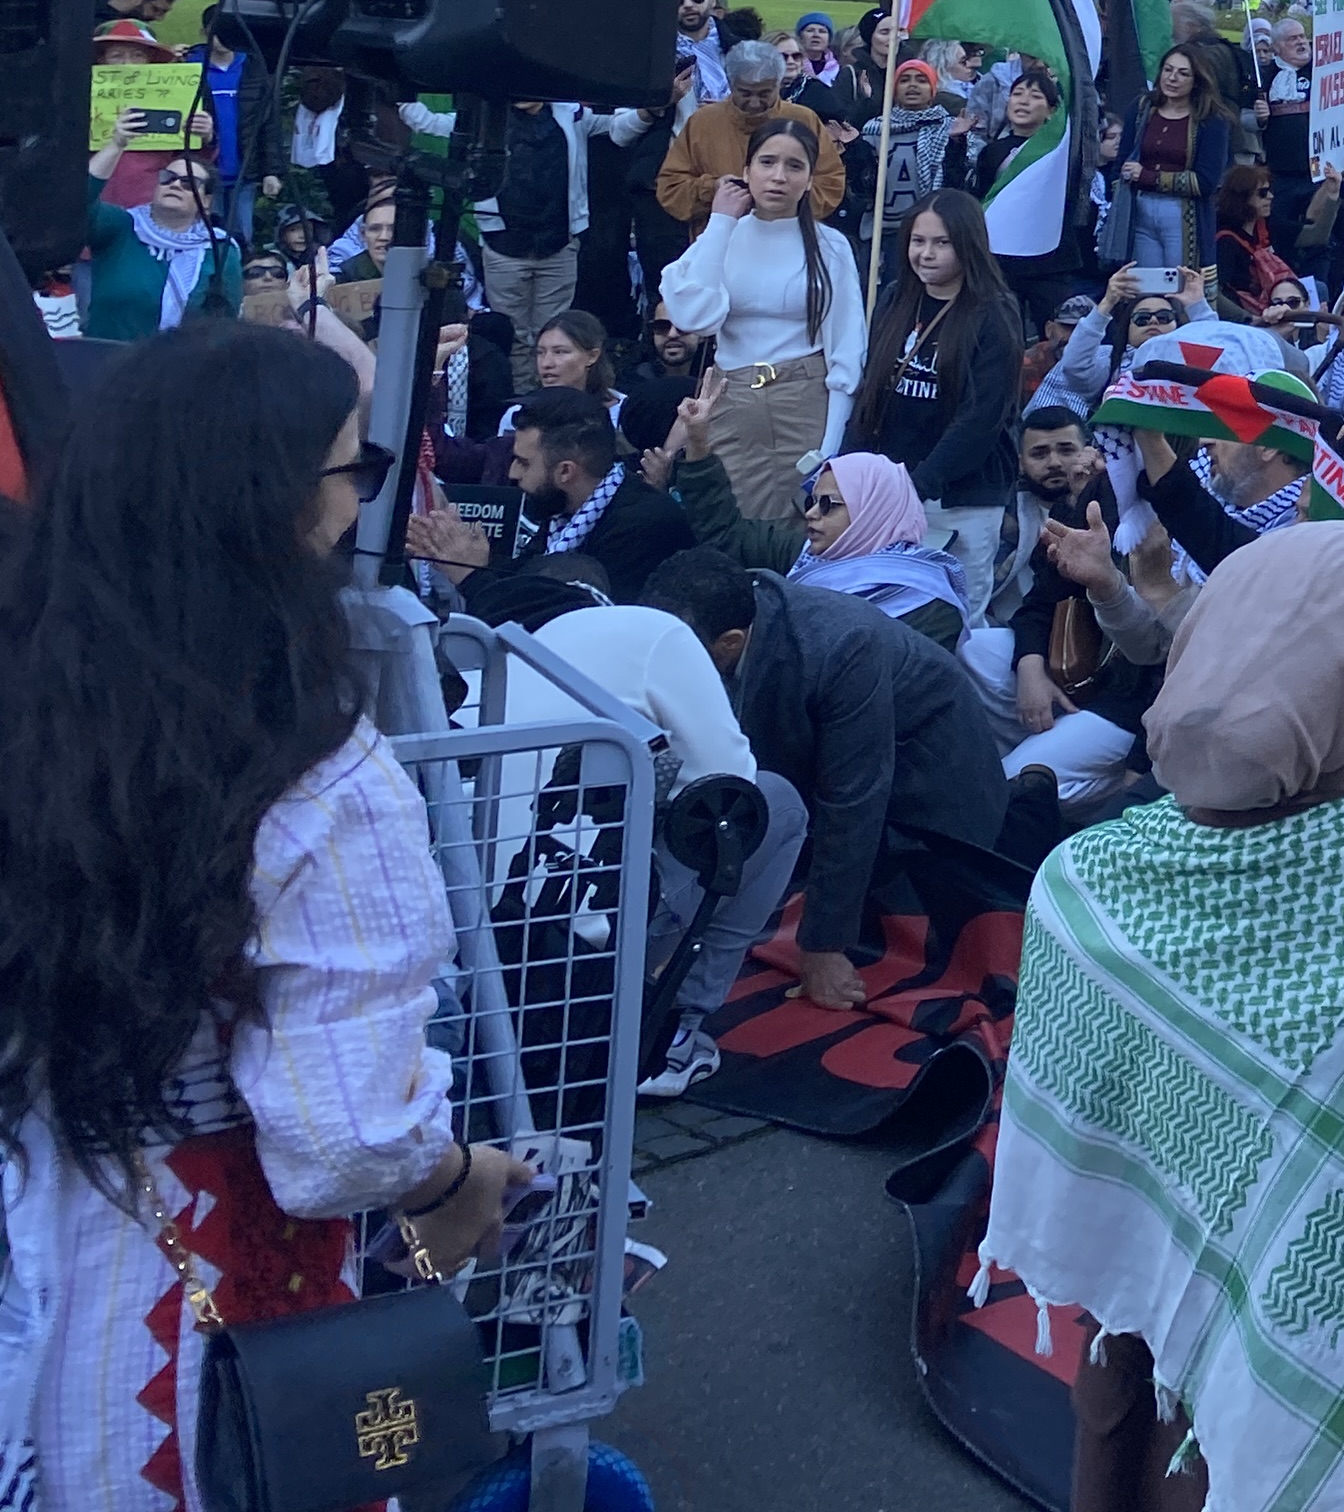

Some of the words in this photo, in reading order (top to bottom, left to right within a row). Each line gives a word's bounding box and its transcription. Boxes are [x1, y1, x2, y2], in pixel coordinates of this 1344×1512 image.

[93, 70, 122, 85] ST
[97, 88, 146, 100] RRIES
[448, 501, 505, 519] REEDOM
